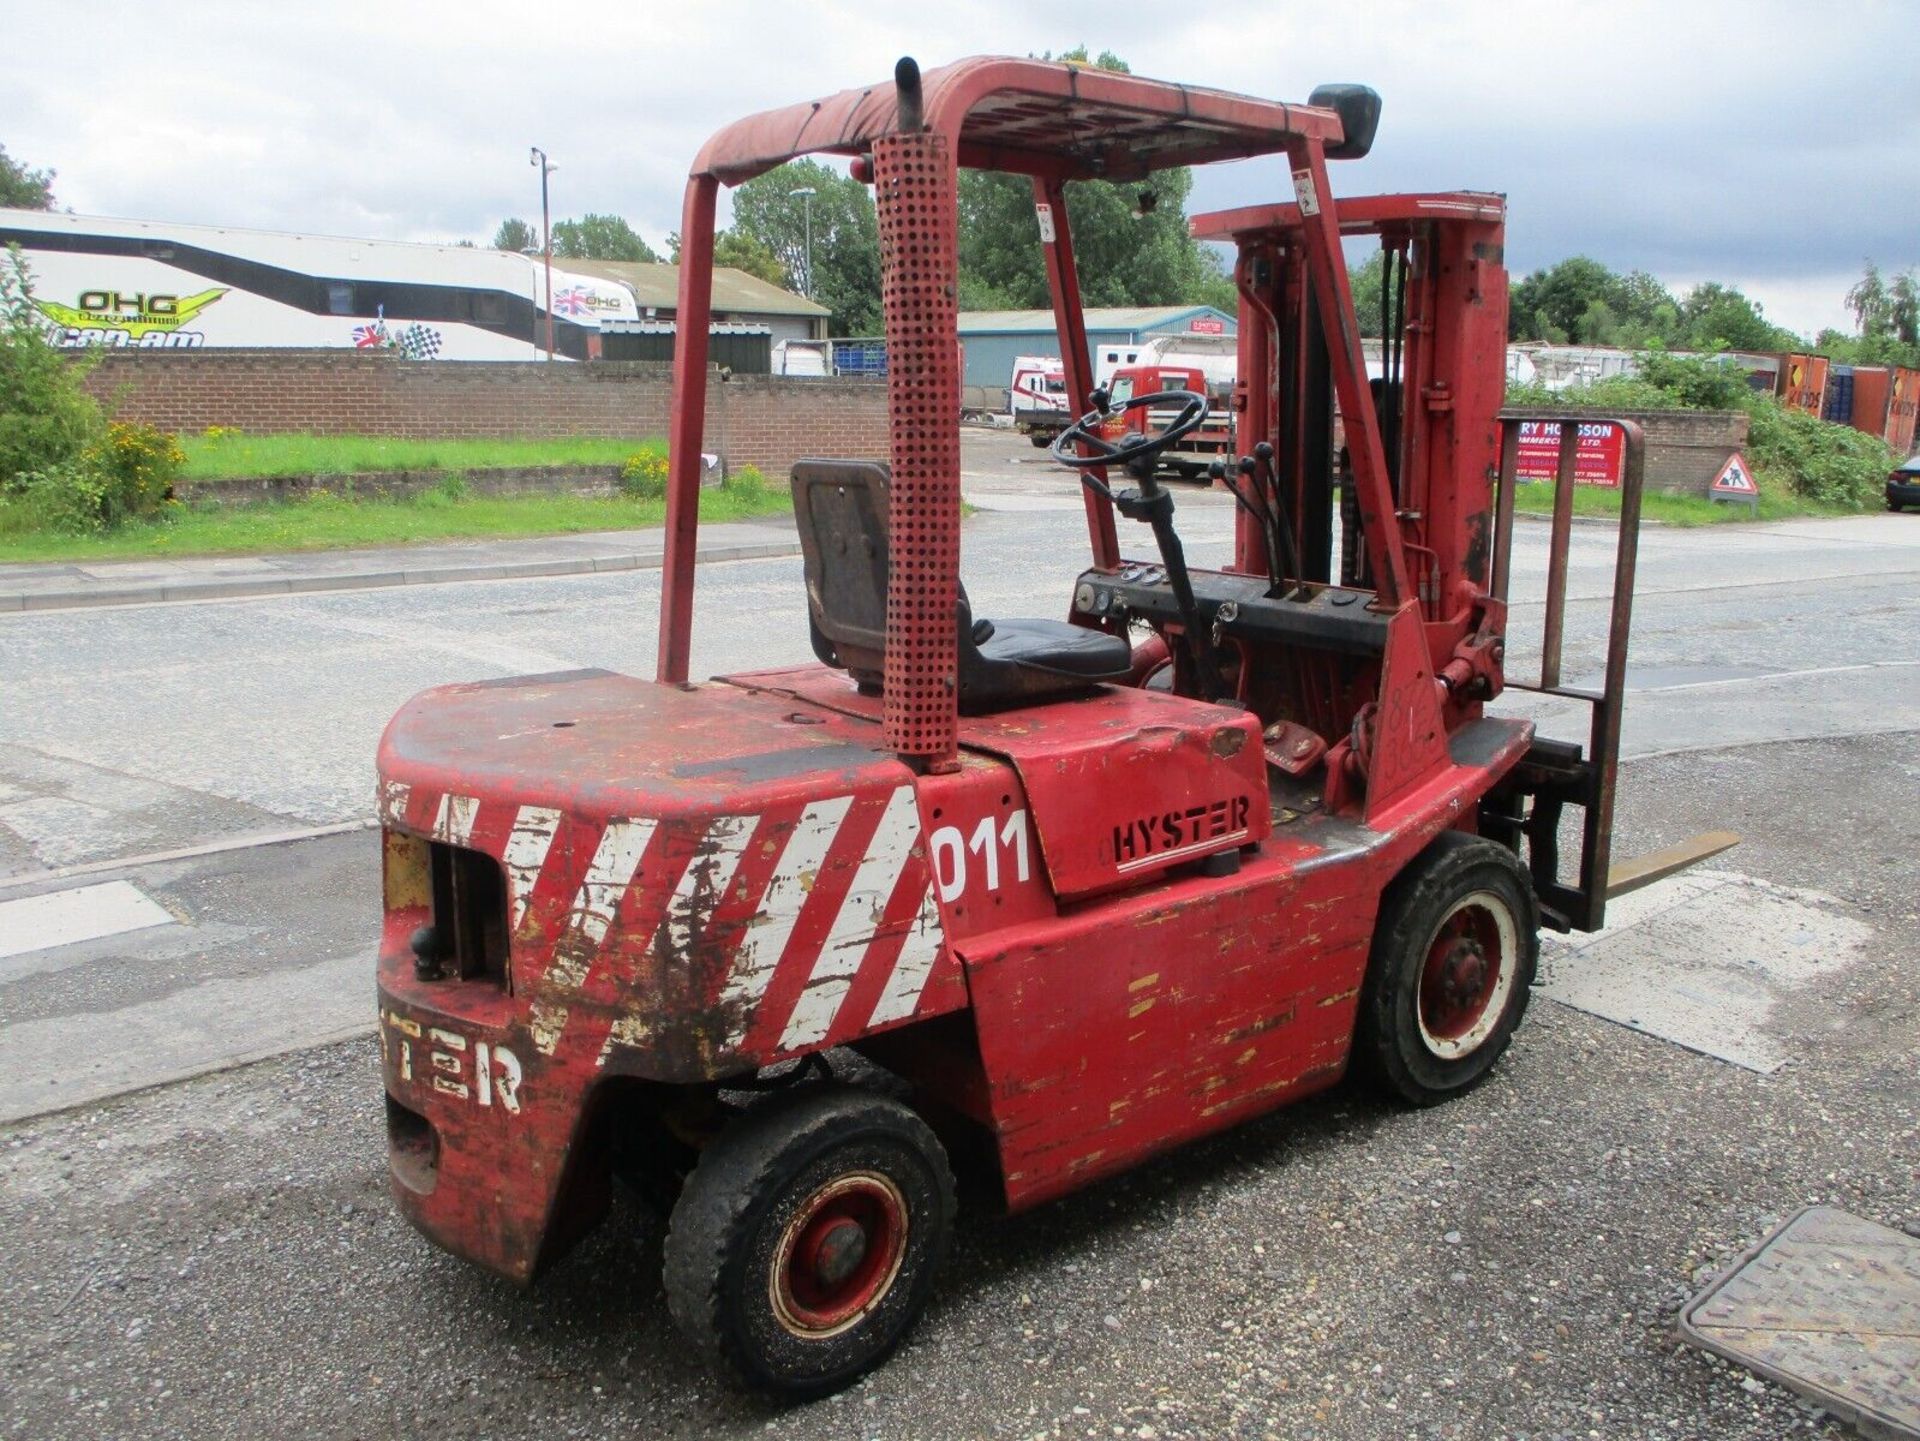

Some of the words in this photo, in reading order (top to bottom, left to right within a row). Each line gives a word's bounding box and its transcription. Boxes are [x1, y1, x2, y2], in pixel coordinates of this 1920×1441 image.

[79, 291, 178, 315] OHG
[586, 297, 620, 307] OHG
[1520, 422, 1540, 434] RY
[1544, 423, 1612, 437] HOSON
[1113, 795, 1250, 863] HYSTER
[930, 809, 1030, 903] 011
[380, 1008, 522, 1115] TER
